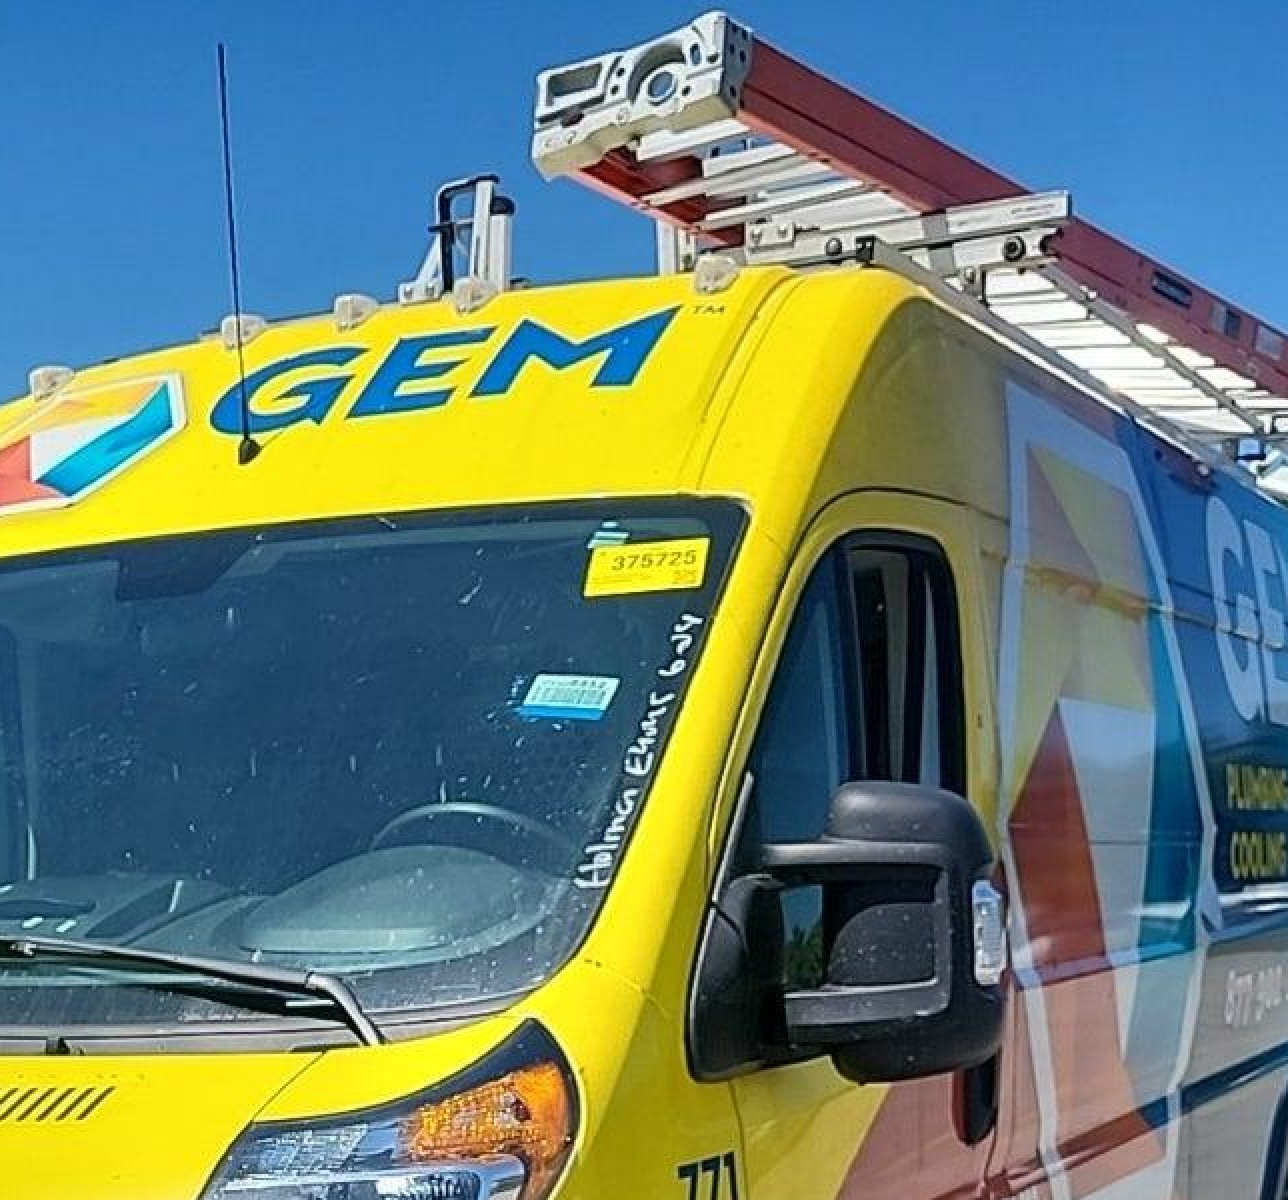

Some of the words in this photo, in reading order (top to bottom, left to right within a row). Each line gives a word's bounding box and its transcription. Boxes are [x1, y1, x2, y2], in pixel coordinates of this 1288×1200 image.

[210, 303, 682, 436] GEM
[611, 549, 698, 571] 375725
[1206, 495, 1288, 727] GE
